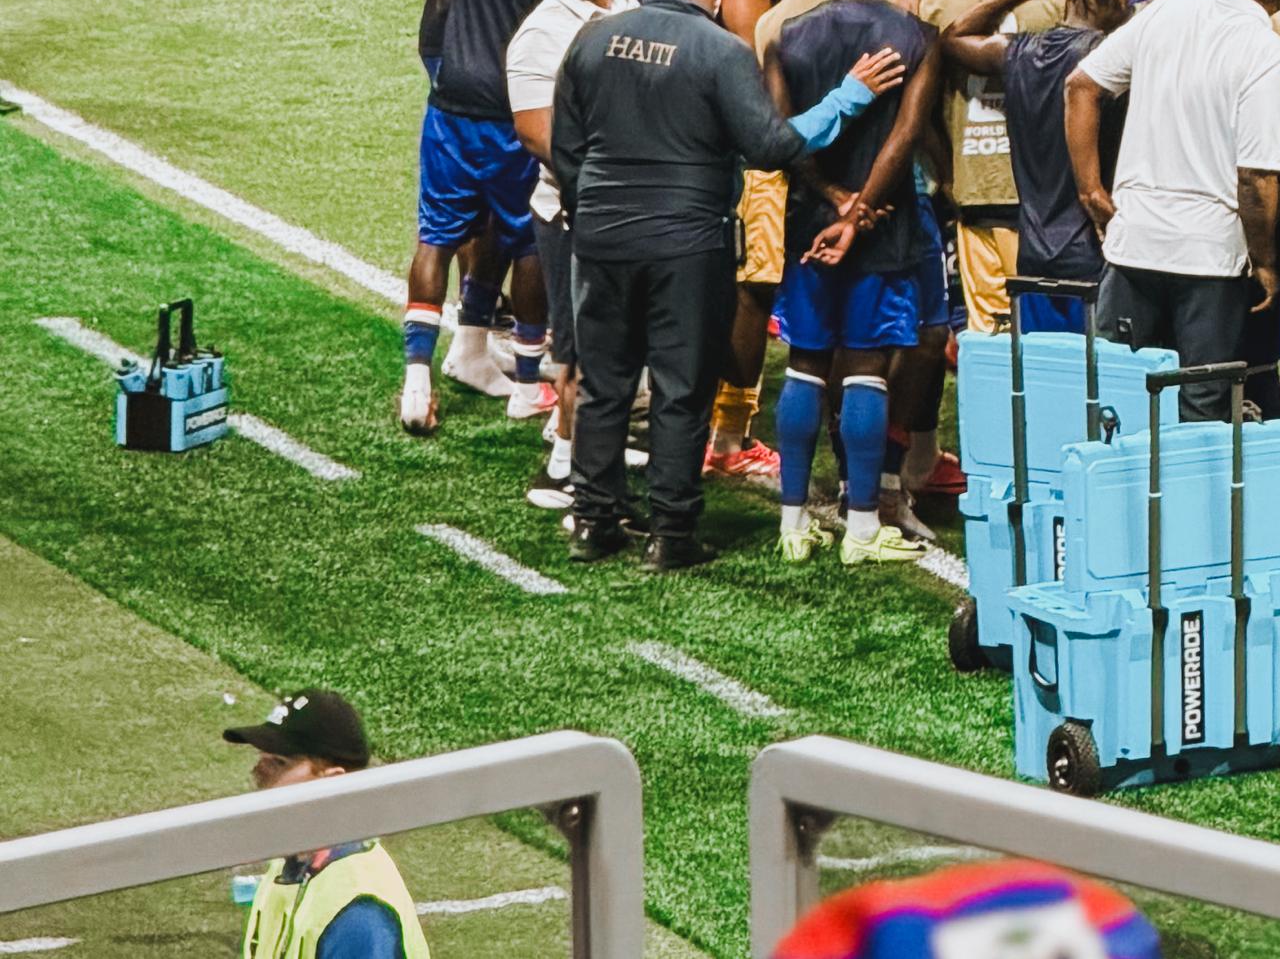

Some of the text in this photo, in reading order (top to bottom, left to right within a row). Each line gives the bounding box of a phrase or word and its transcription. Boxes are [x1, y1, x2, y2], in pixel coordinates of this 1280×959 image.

[605, 35, 677, 66] HAITI
[962, 136, 1011, 156] 202
[1184, 618, 1201, 740] POWERADE
